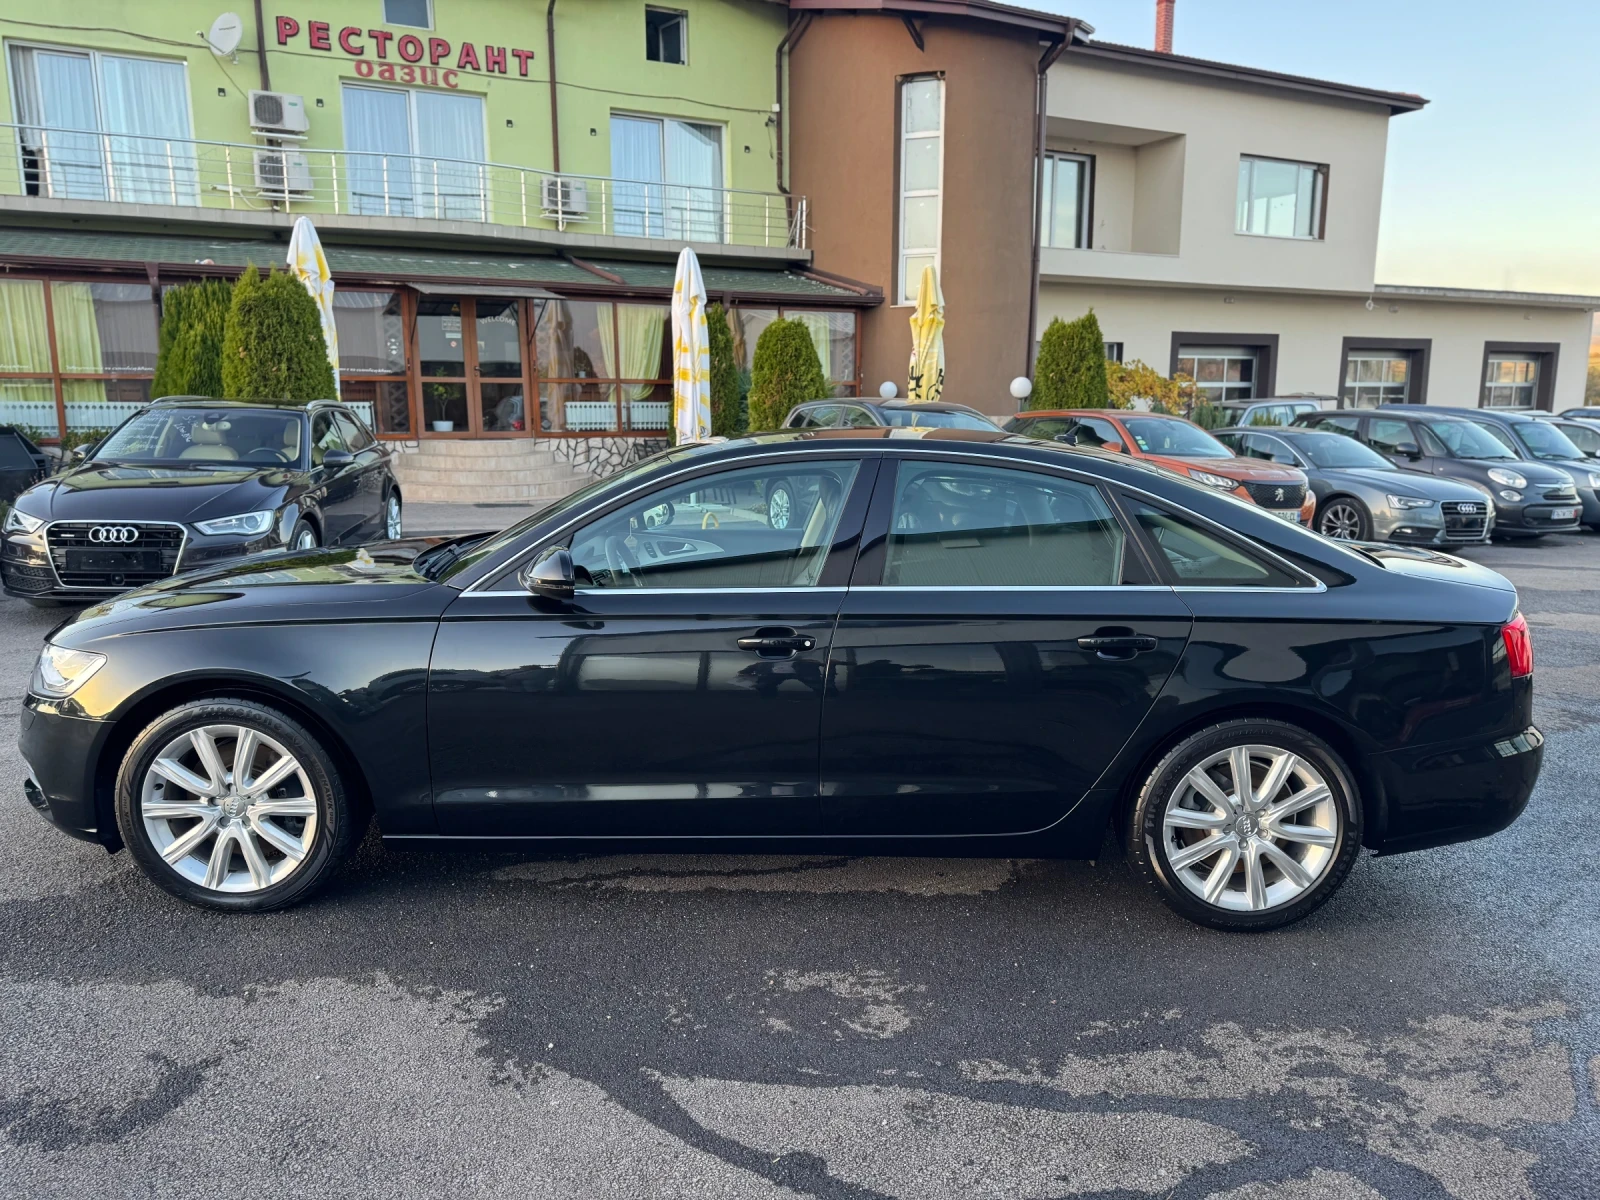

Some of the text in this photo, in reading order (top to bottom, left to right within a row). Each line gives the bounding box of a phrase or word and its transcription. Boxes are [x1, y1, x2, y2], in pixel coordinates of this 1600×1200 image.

[275, 15, 534, 77] РЕСТОРАНТ
[354, 59, 459, 89] оазис
[480, 315, 517, 327] WELCOME
[199, 705, 283, 731] Firestone
